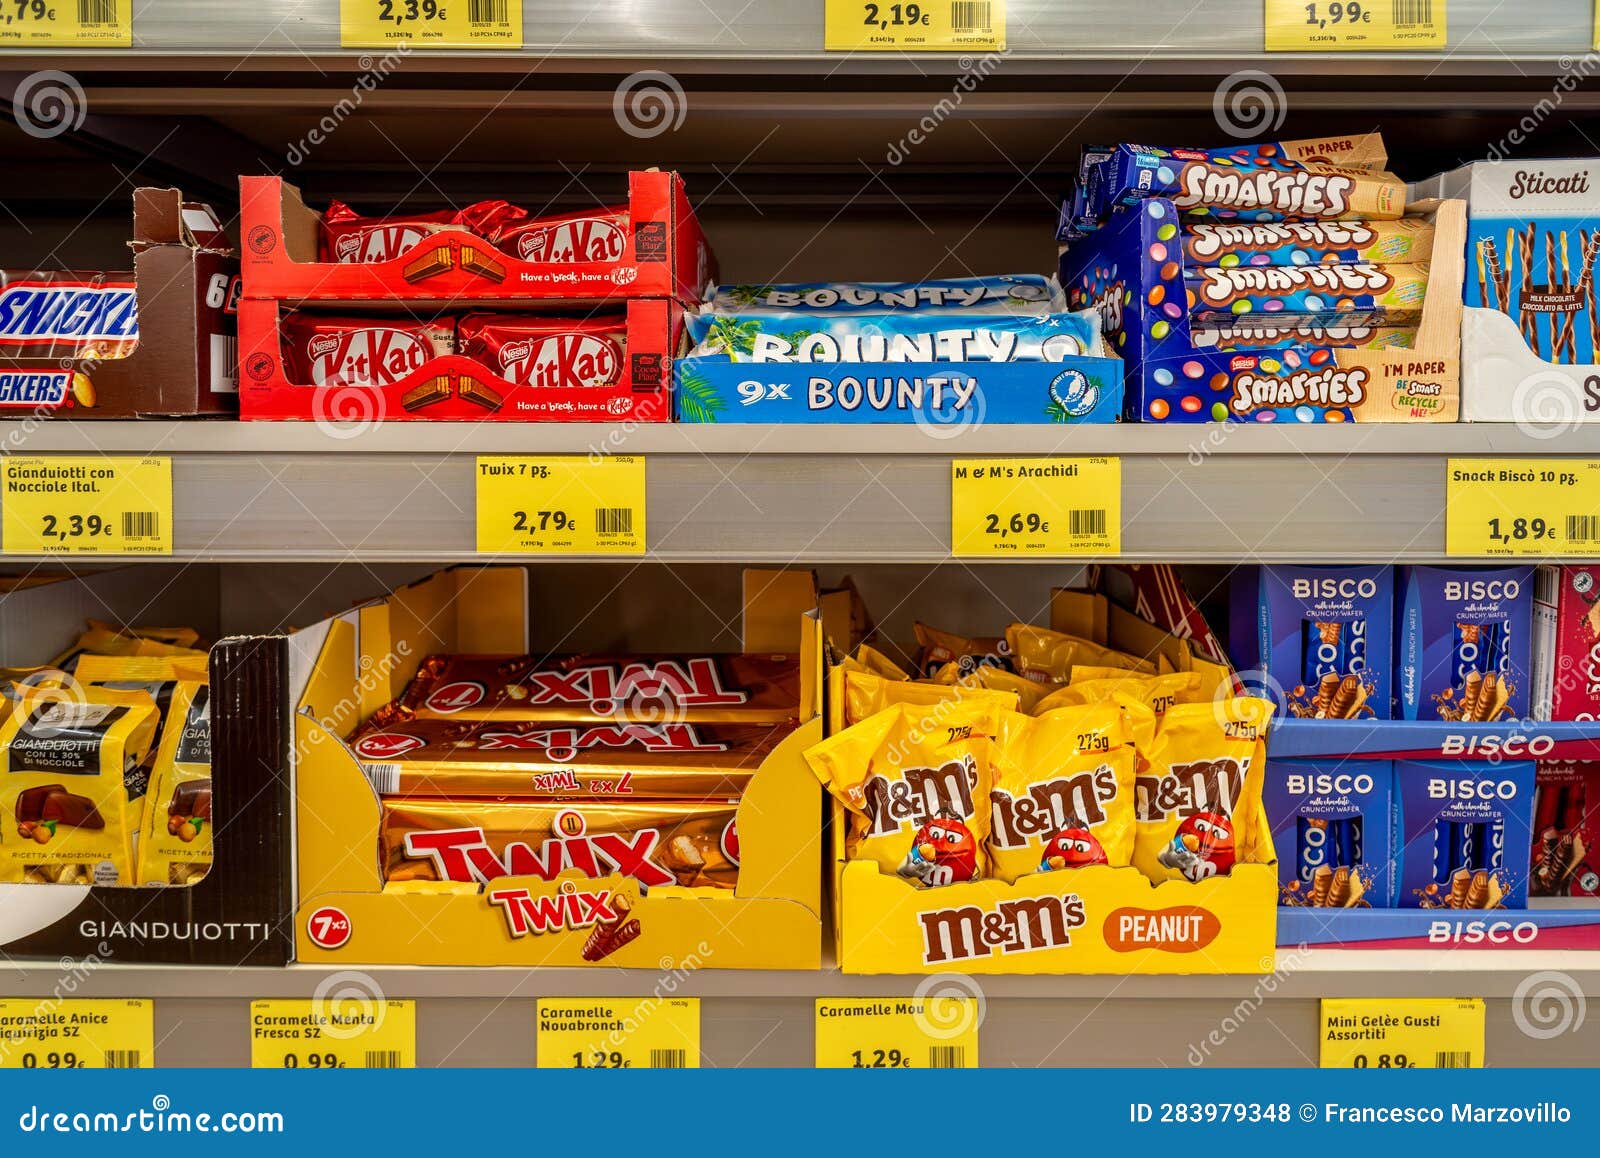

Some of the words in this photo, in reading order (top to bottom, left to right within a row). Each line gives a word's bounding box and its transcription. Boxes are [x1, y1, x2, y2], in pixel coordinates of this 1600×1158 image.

[378, 0, 447, 25] 2,39€
[864, 3, 930, 30] 2,19€
[1305, 2, 1371, 29] 1,99€
[1319, 140, 1354, 154] PAPER
[1509, 170, 1590, 199] Sticati
[520, 273, 543, 282] Have
[582, 273, 602, 282] have
[765, 286, 990, 309] BOUNTY
[1522, 302, 1556, 312] CIOCCOLATO
[1557, 304, 1564, 312] AL
[1564, 302, 1583, 311] LATTE
[1530, 294, 1542, 302] MILK
[1543, 294, 1576, 303] CHOCOLATE
[752, 329, 1019, 362] BOUNTY
[323, 329, 421, 386] KitKat
[514, 335, 610, 387] KitKat
[1384, 364, 1404, 377] I'M
[1407, 361, 1445, 376] PAPER
[0, 375, 65, 401] CKERS
[808, 376, 977, 410] BOUNTY
[1396, 380, 1407, 390] BE
[1408, 381, 1441, 396] SMART
[517, 402, 540, 411] Have
[578, 402, 598, 411] have
[1398, 396, 1438, 409] RECYCLE
[1411, 409, 1428, 418] ME!
[8, 467, 86, 479] Gianduiotti
[90, 470, 114, 479] con
[480, 463, 515, 475] Twix
[519, 464, 527, 475] 7
[956, 467, 967, 478] M
[973, 468, 985, 478] &
[989, 467, 1014, 478] M's
[1018, 464, 1078, 478] Arachidi
[1453, 470, 1495, 482] Snack
[1499, 469, 1535, 482] Biscò
[1540, 471, 1555, 482] 10
[8, 481, 67, 492] Nocciole
[72, 481, 100, 492] Ital.
[42, 515, 112, 541] 2,39€
[513, 511, 576, 535] 2,79€
[985, 513, 1049, 538] 2,69€
[1488, 518, 1556, 545] 1,89€
[1292, 578, 1377, 599] BISCO
[1444, 580, 1520, 601] BISCO
[1409, 608, 1417, 631] WAFER
[1409, 632, 1417, 664] CRUNCHY
[530, 658, 747, 716] Twix
[1224, 721, 1257, 741] 275g
[1077, 733, 1109, 752] 275g
[1442, 735, 1555, 756] BISCO
[25, 750, 46, 758] CON
[62, 752, 81, 760] 30%
[36, 759, 85, 768] NOCCIOLE
[534, 769, 580, 792] Twix
[1287, 774, 1374, 796] BISCO
[1428, 779, 1517, 800] BISCO
[405, 809, 676, 886] Twix
[490, 881, 617, 937] Twix
[79, 920, 269, 941] GIANDUIOTTI
[921, 895, 1085, 965] m&m's
[1119, 915, 1203, 943] PEANUT
[1428, 920, 1539, 944] BISCO
[0, 1013, 66, 1026] aramelle
[70, 1012, 109, 1024] Anice
[254, 1014, 327, 1026] Caramelle
[331, 1014, 375, 1025] Menta
[541, 1007, 613, 1018] Caramelle
[820, 1003, 891, 1017] Caramelle
[895, 1003, 925, 1015] Mou
[541, 1020, 624, 1031] Novabronch
[1327, 1016, 1357, 1028] Mini
[1361, 1014, 1399, 1027] Gelèe
[1404, 1015, 1440, 1027] Gusti
[63, 1026, 80, 1038] SZ
[255, 1028, 300, 1039] Fresca
[304, 1028, 321, 1039] SZ
[1327, 1028, 1386, 1041] Assortiti
